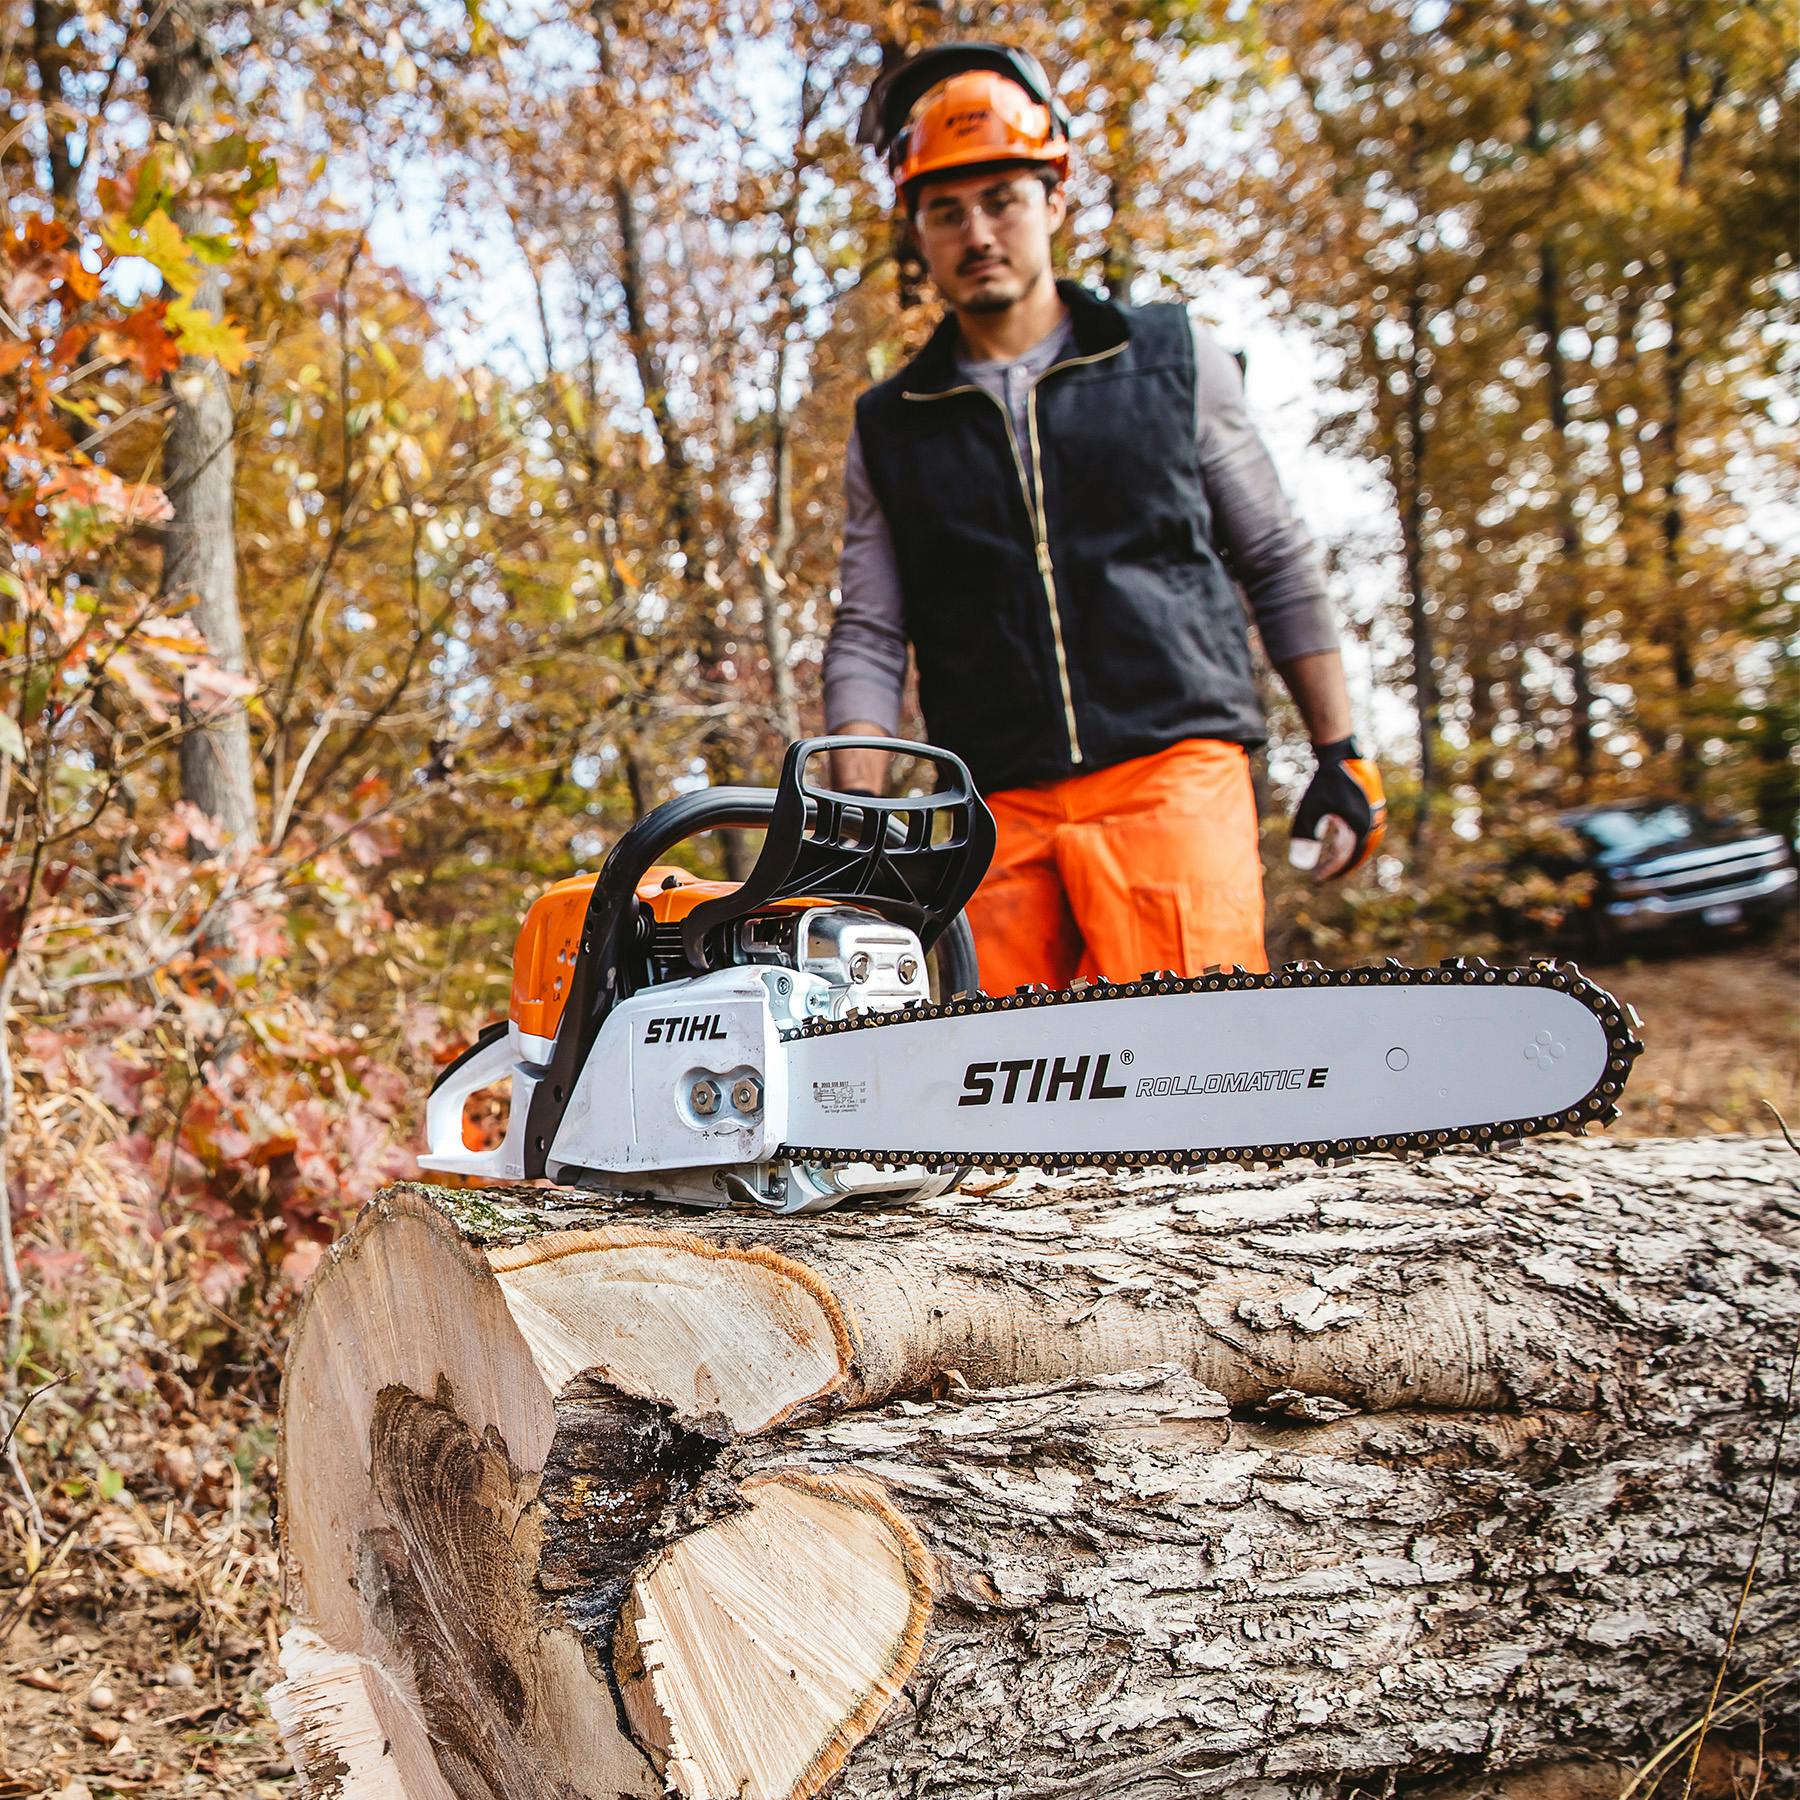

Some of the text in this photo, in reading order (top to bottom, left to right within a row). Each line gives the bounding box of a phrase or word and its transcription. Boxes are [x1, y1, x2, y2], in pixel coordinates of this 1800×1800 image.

[644, 1014, 728, 1044] STIHL
[1135, 1069, 1305, 1098] ROLLOMATIC
[1307, 1067, 1329, 1088] E
